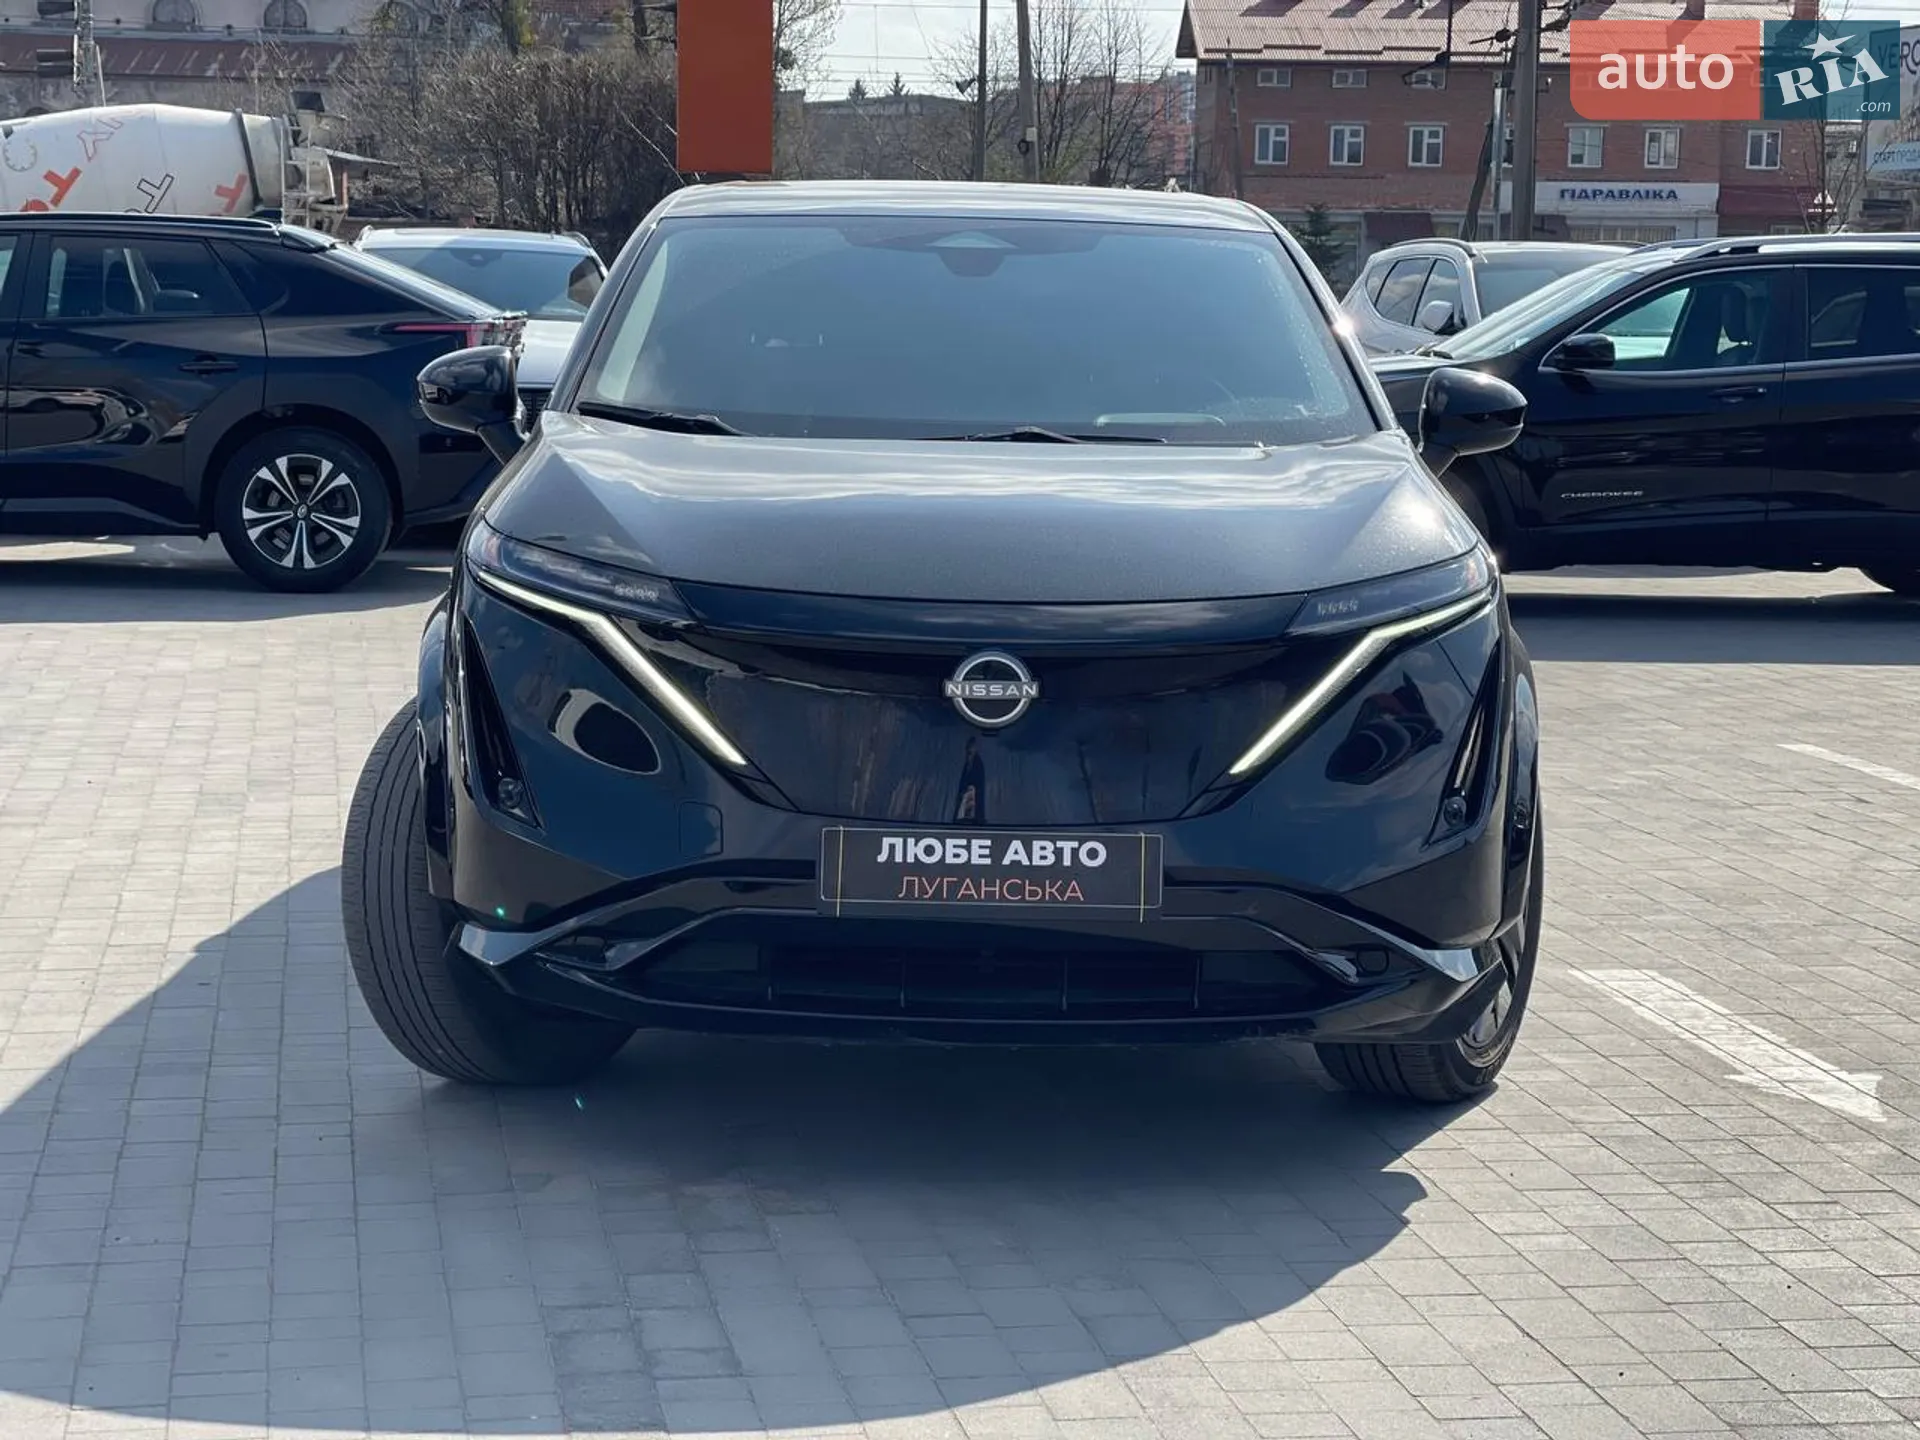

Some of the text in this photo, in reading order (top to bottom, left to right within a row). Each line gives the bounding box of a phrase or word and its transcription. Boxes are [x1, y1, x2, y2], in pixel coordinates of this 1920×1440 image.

[1559, 188, 1679, 200] ГІДРАВЛІКА
[1560, 490, 1644, 499] CHEROKEE
[947, 684, 1036, 696] NISSAN
[877, 837, 1107, 867] ЛЮБЕ АВТО
[898, 876, 1084, 901] ЛУГАНСЬКА
